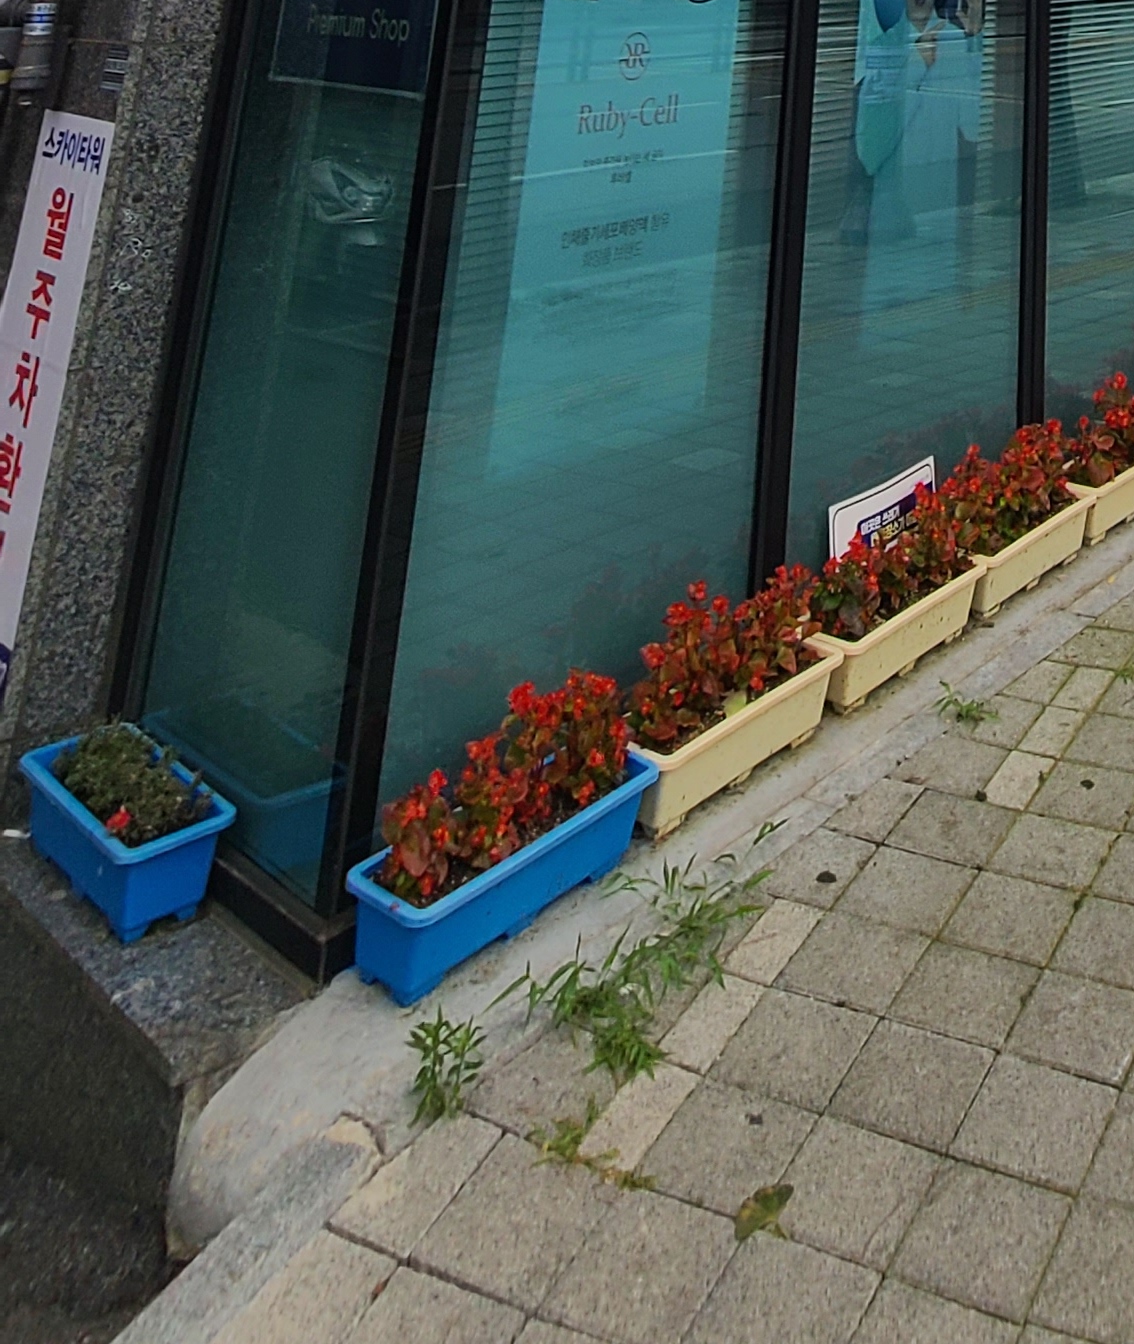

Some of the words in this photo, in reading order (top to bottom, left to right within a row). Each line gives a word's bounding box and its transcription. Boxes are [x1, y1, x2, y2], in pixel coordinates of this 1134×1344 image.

[307, 3, 366, 38] Premium
[368, 8, 410, 48] Shop
[42, 126, 106, 176] 스카이타워
